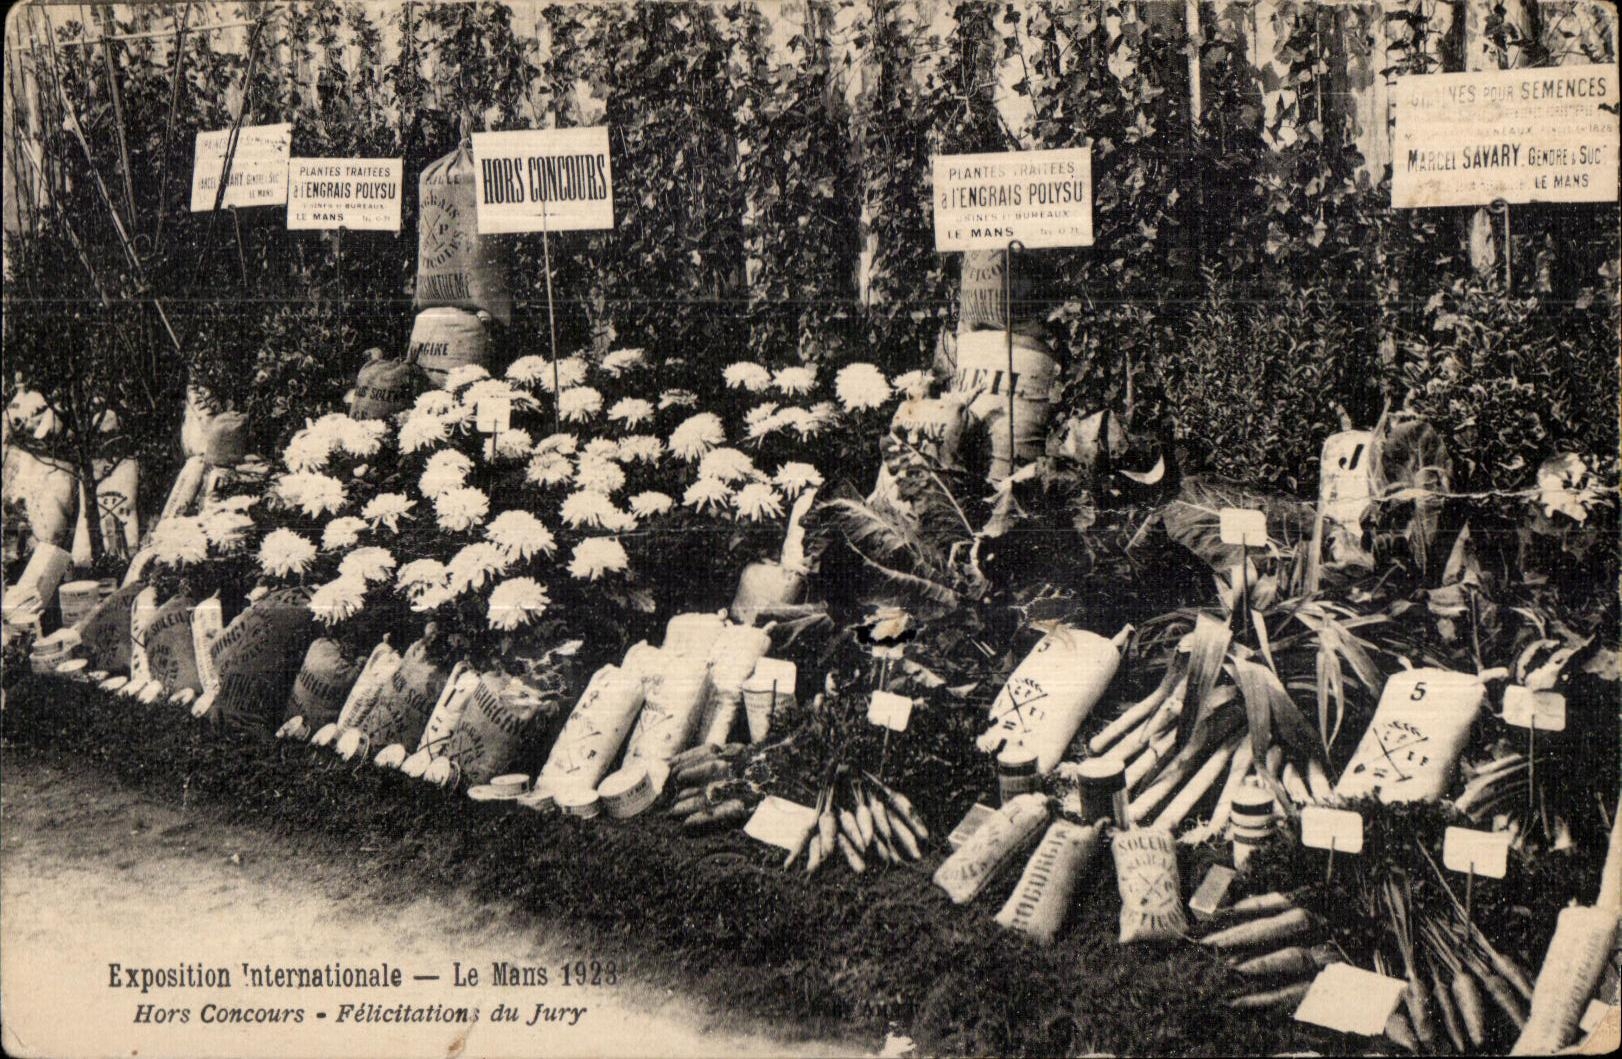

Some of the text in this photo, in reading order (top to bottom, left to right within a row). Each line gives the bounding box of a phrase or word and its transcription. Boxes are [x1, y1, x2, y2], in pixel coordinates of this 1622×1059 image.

[1483, 86, 1514, 101] POUR
[1521, 77, 1607, 100] SEMENCES
[1407, 149, 1457, 172] MARCEL
[300, 167, 341, 176] PLANTES
[481, 154, 607, 204] HORS CONCOURS
[949, 166, 1006, 181] PLANTES
[1535, 175, 1548, 189] LE
[1553, 174, 1590, 188] MANS
[356, 182, 396, 199] POLYSU
[1029, 180, 1083, 205] POLYSU
[296, 213, 307, 221] LE
[313, 213, 344, 221] MANS
[947, 230, 962, 240] LE
[971, 227, 1014, 238] MANS
[1410, 681, 1428, 701] 5
